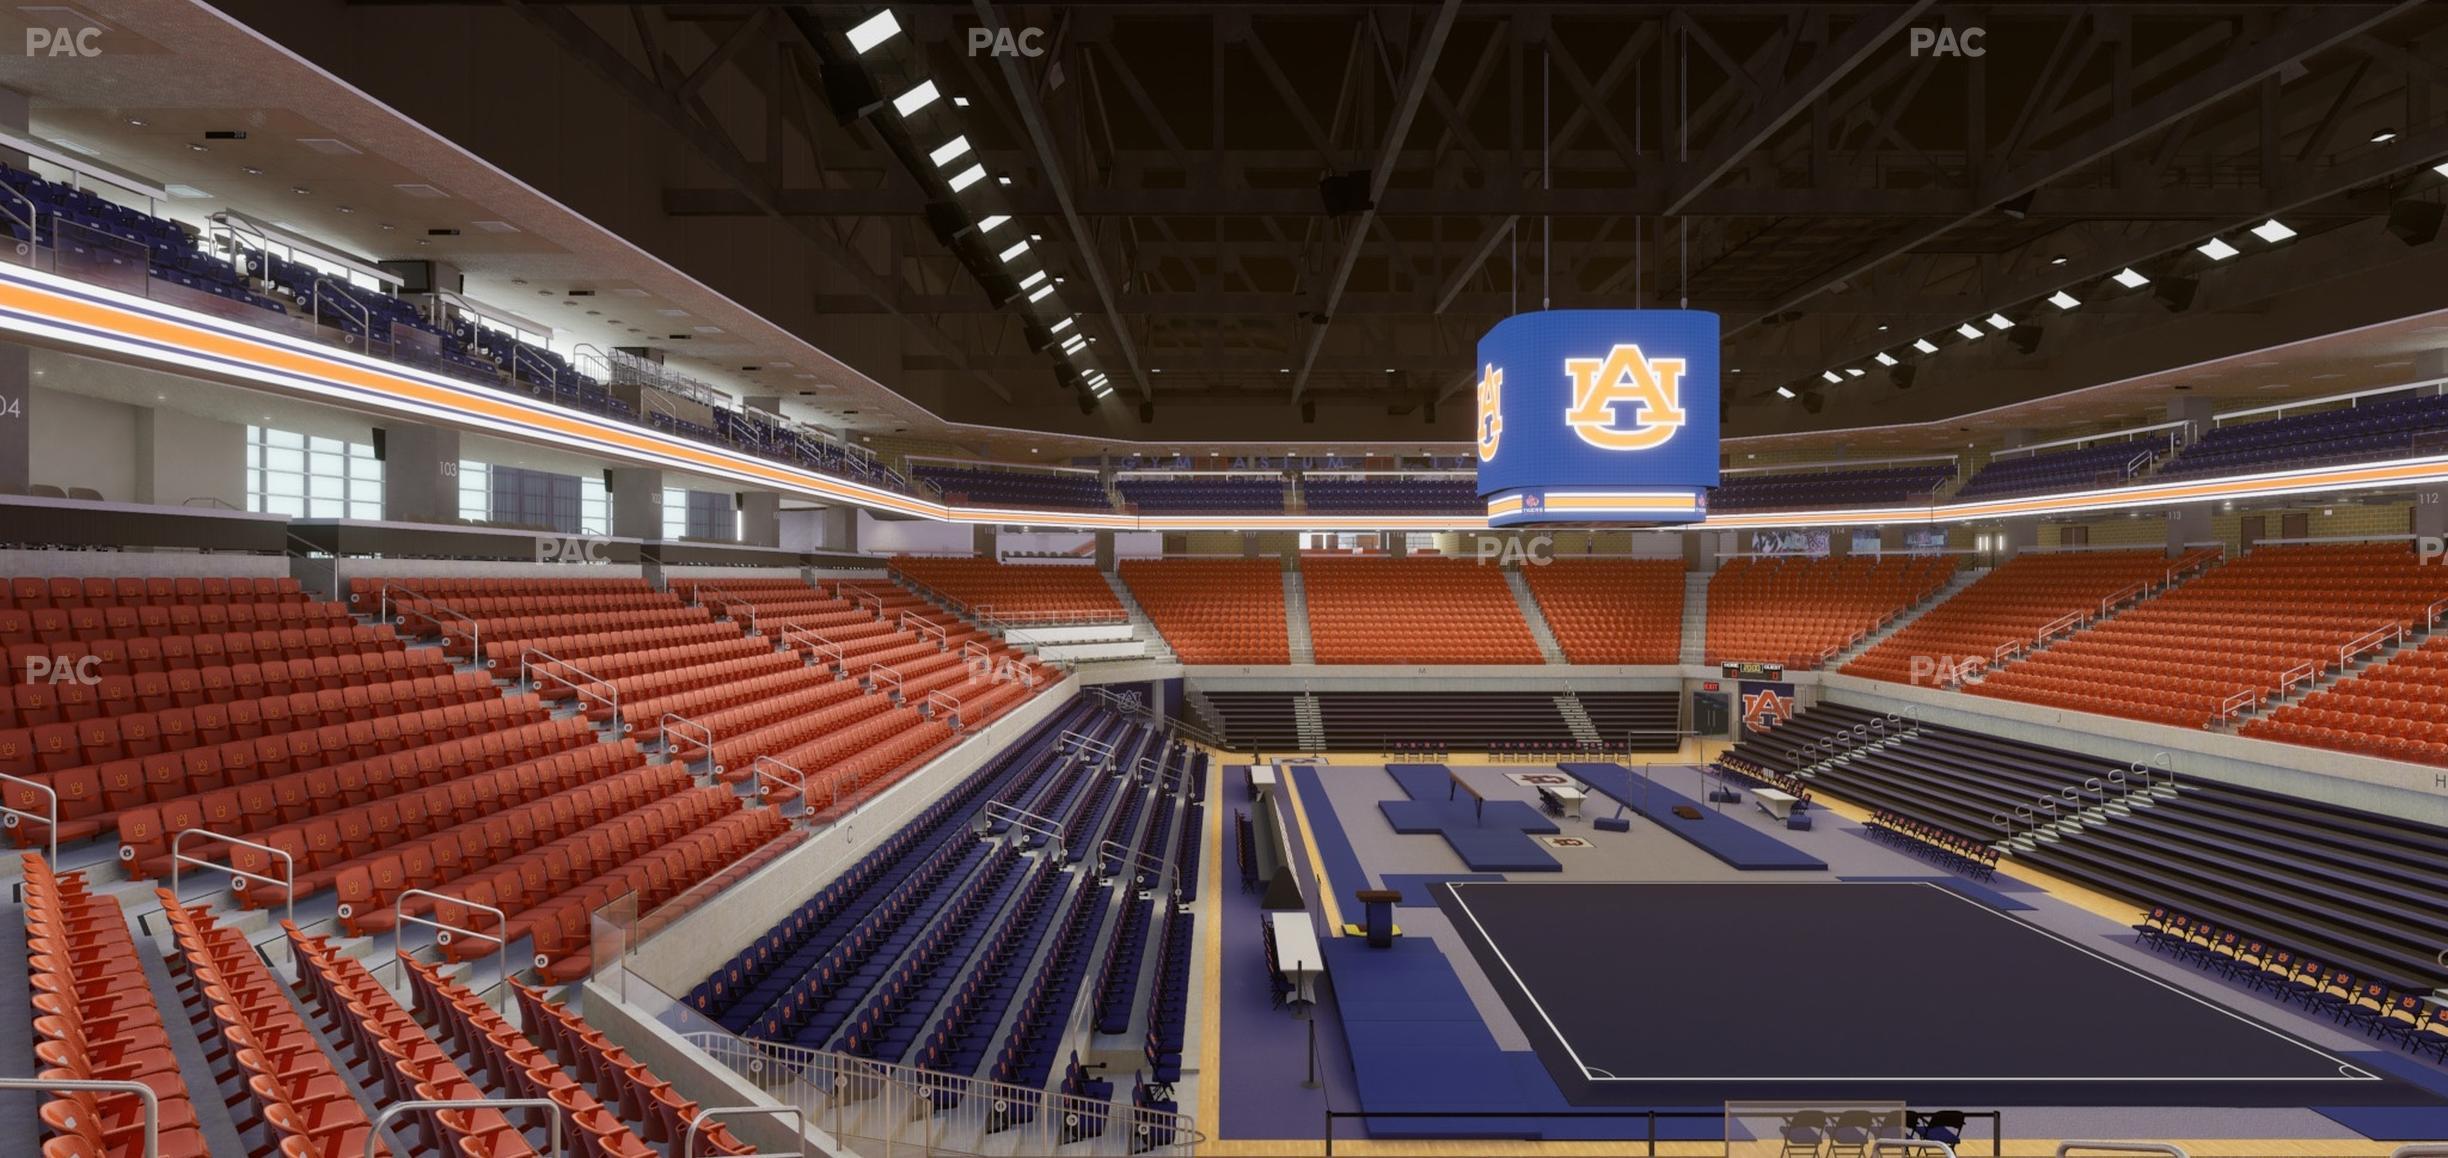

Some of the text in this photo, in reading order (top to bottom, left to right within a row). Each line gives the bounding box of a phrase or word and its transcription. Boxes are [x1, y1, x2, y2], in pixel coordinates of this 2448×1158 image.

[440, 461, 457, 477] 103
[2419, 492, 2439, 504] 112
[2168, 511, 2181, 520] 113
[2435, 773, 2447, 789] H
[847, 825, 854, 844] C
